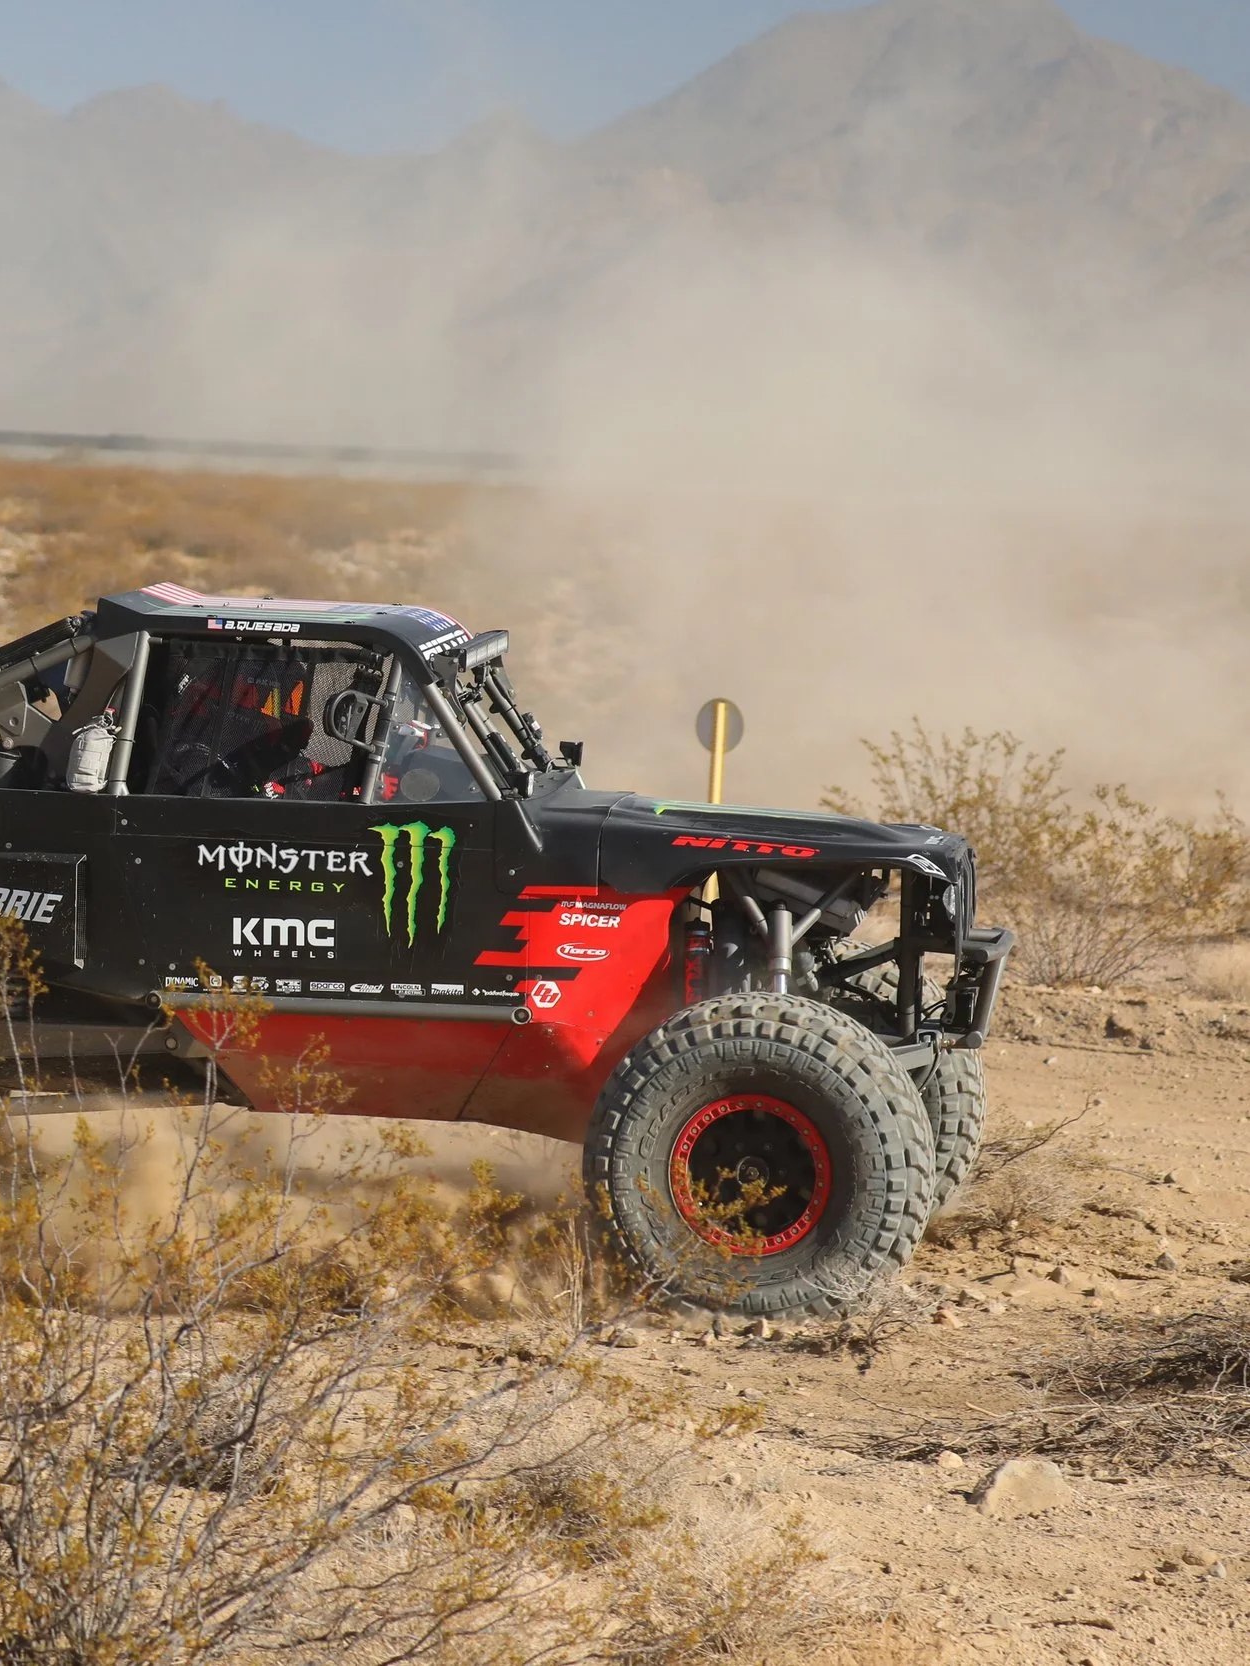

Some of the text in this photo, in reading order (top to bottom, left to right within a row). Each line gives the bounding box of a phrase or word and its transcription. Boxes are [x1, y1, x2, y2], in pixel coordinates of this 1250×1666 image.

[671, 835, 816, 858] NITTO
[197, 841, 373, 877] MONSTER
[225, 878, 345, 893] ENERGY
[559, 912, 621, 928] SPICER
[233, 949, 335, 959] WHEELS
[165, 976, 199, 987] DYNAMIC
